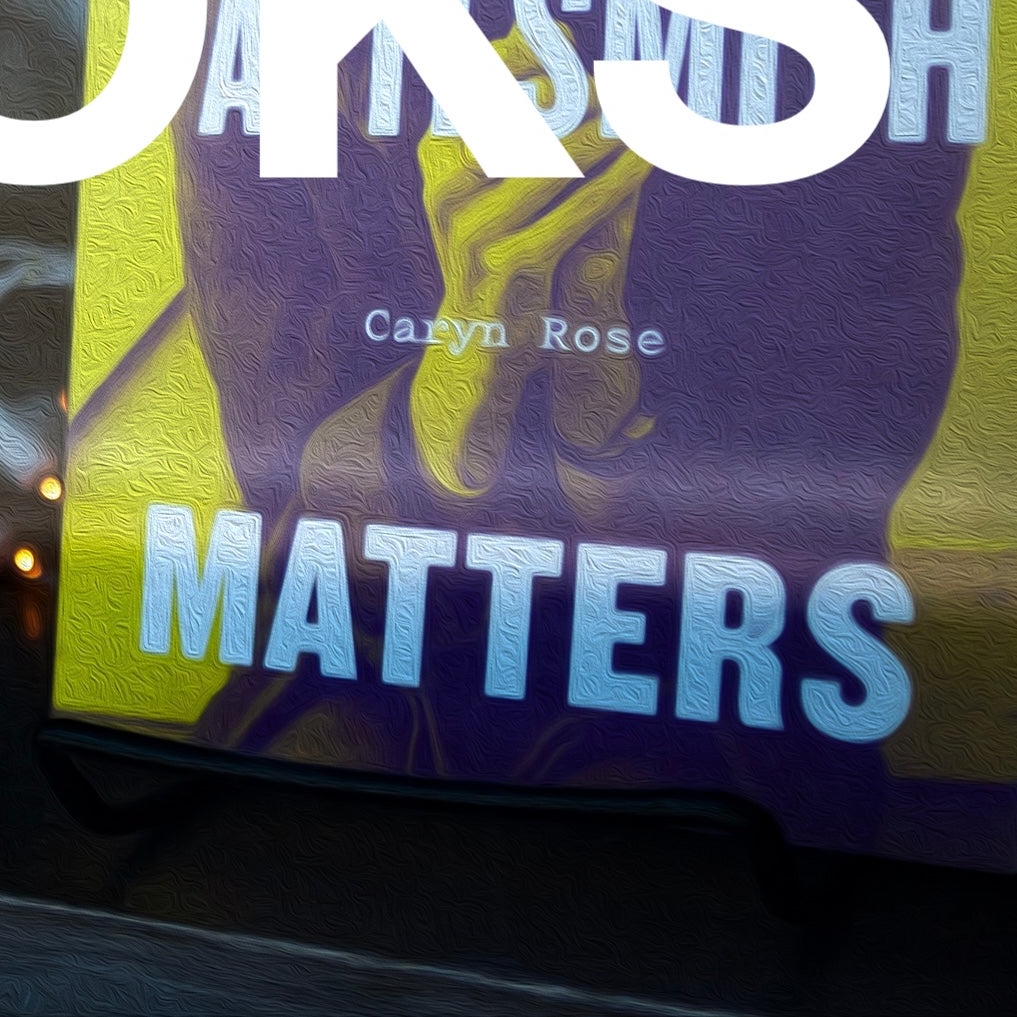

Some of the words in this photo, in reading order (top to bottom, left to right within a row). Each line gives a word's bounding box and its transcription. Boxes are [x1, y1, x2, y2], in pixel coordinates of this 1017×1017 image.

[364, 309, 510, 356] Caryn
[539, 315, 667, 355] Rose
[138, 501, 916, 744] MATTERS
